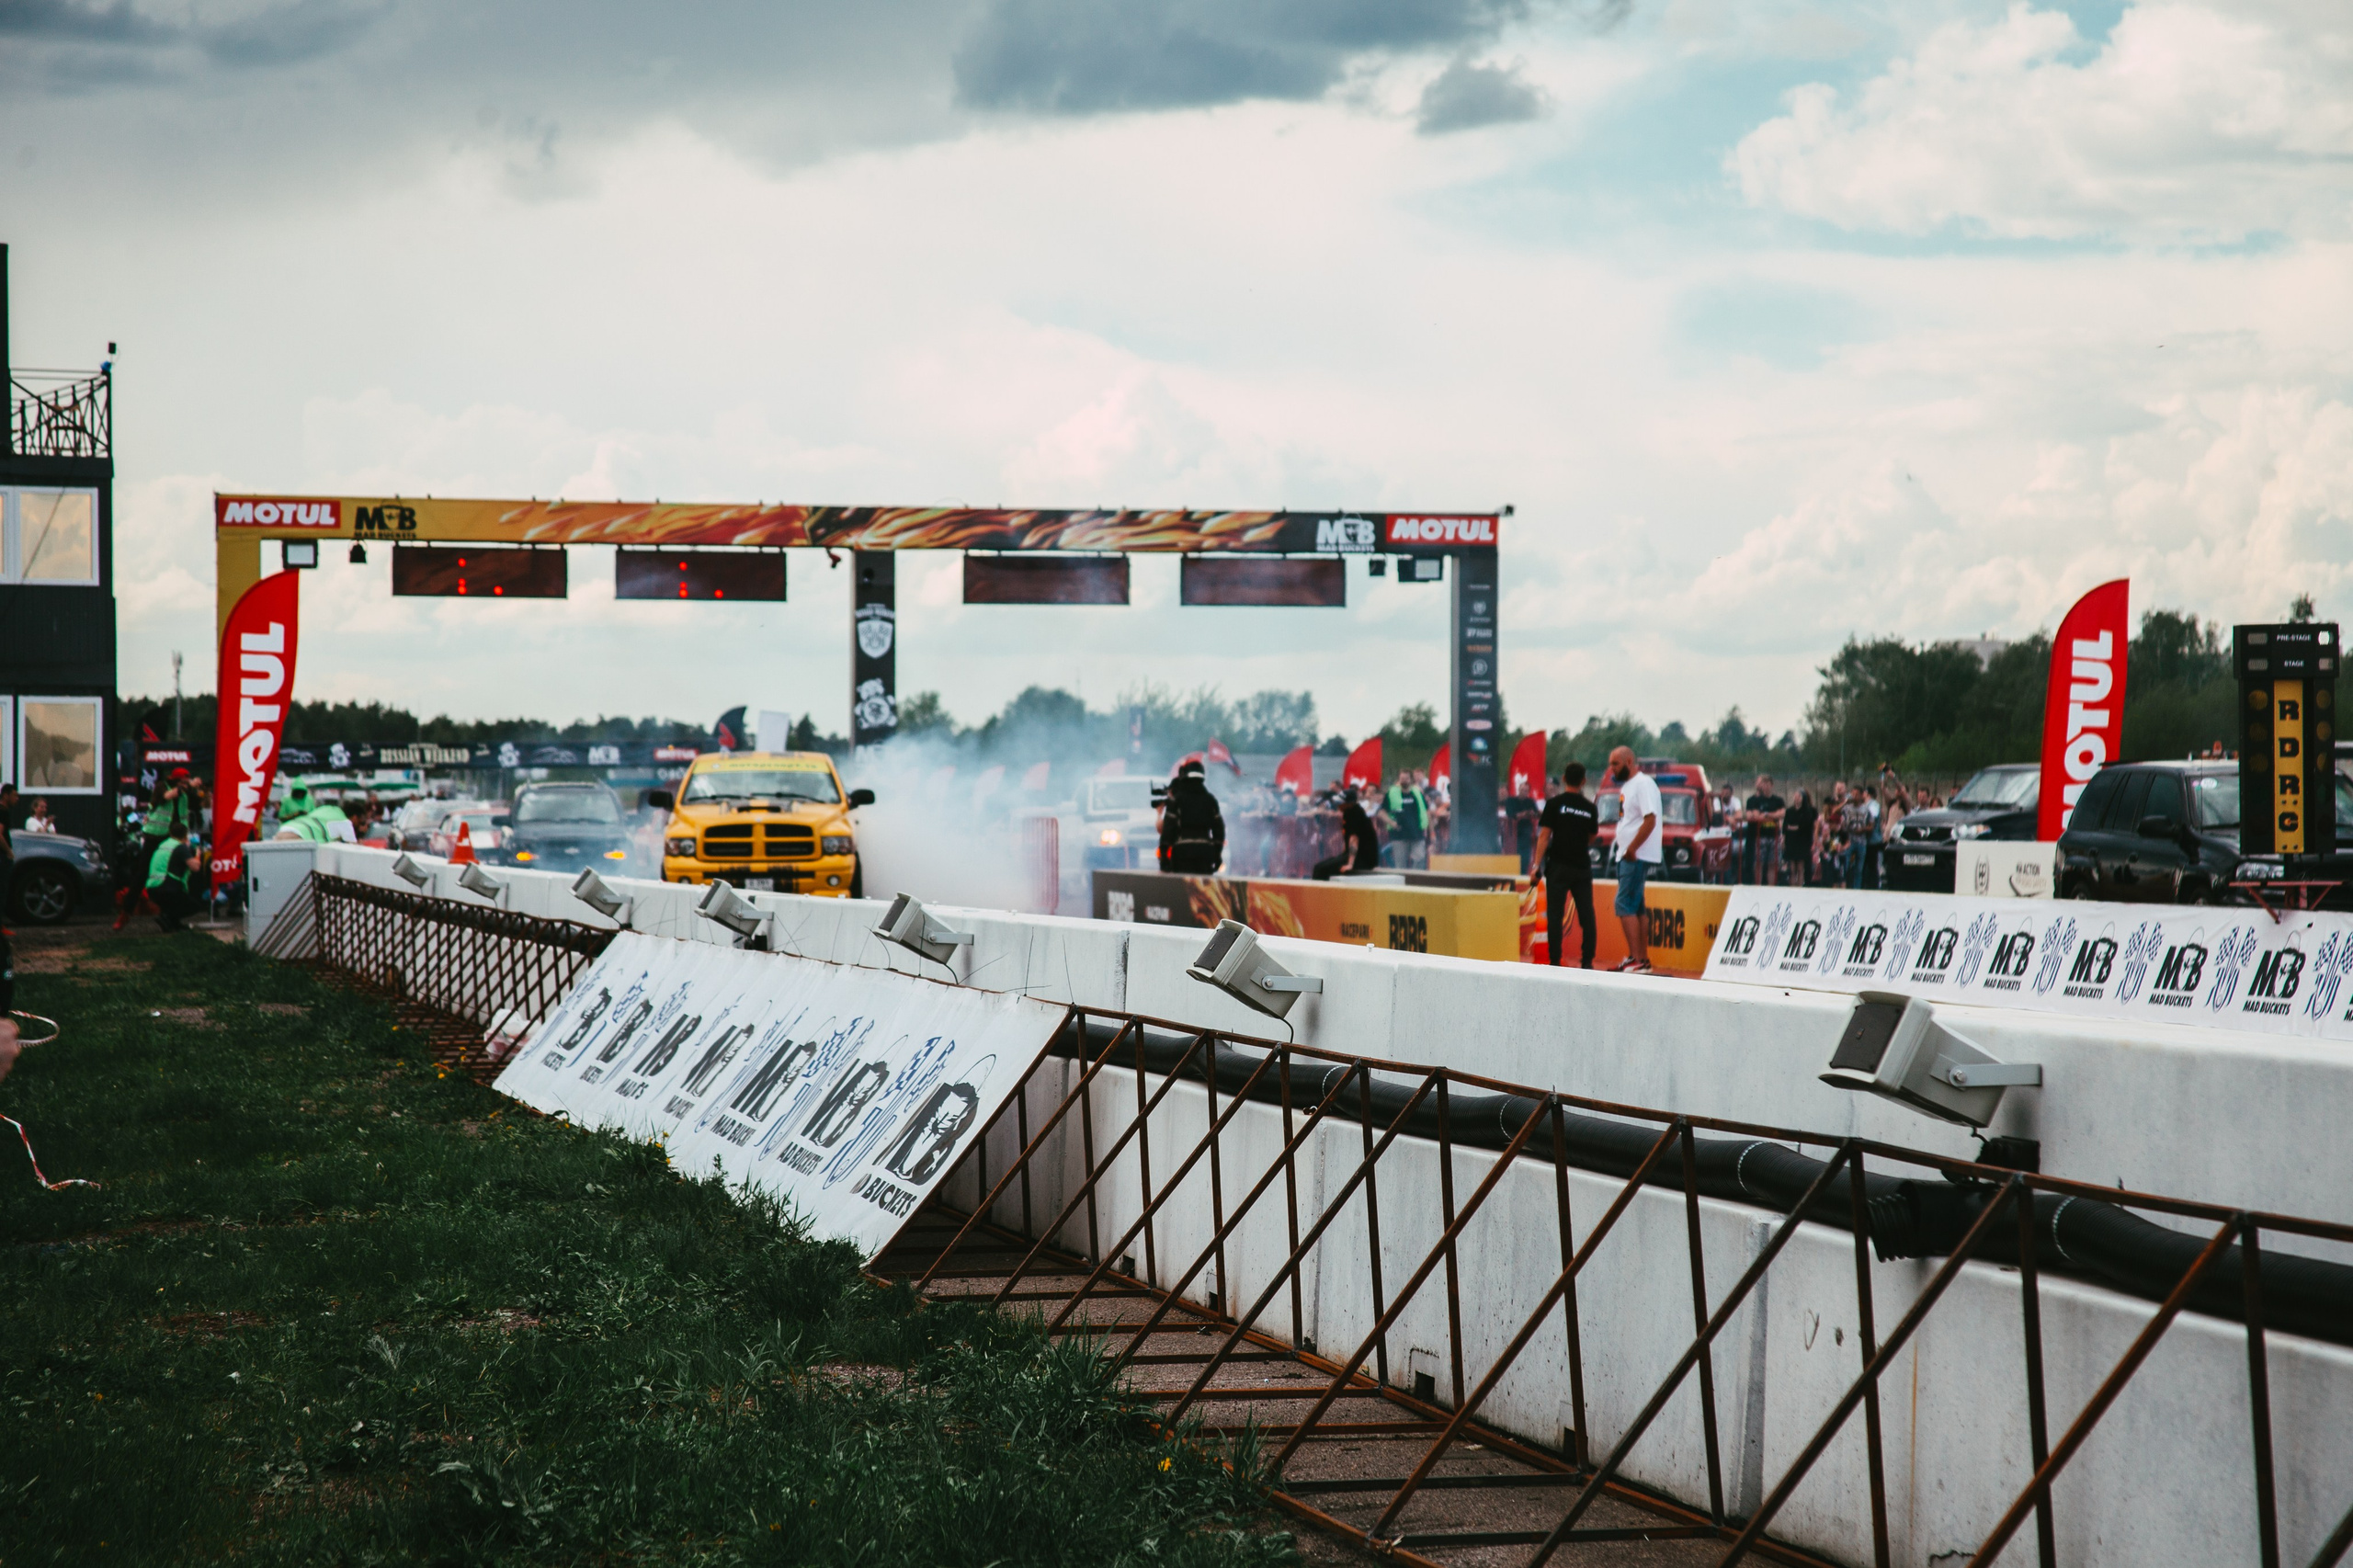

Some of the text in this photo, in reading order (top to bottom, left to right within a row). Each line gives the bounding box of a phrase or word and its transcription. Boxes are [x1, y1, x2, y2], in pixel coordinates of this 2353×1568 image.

[223, 502, 335, 526] MOTUL
[1392, 518, 1495, 541] MOTUL
[2277, 633, 2311, 642] PRE-STAGE
[233, 621, 285, 824] MOTUL
[145, 751, 190, 762] MOTUL
[1389, 915, 1427, 952] RDRC
[1911, 972, 1946, 984] MAD BUCKETS
[1984, 979, 2021, 992] MAD BUCKETS
[2063, 985, 2104, 1000] MAD BUCKETS
[2149, 994, 2193, 1008] MAD BUCKETS
[2243, 1000, 2291, 1016] MAD BUCKETS
[710, 1114, 737, 1138] MAD
[777, 1142, 800, 1165] AD
[861, 1176, 918, 1220] BUCKETS
